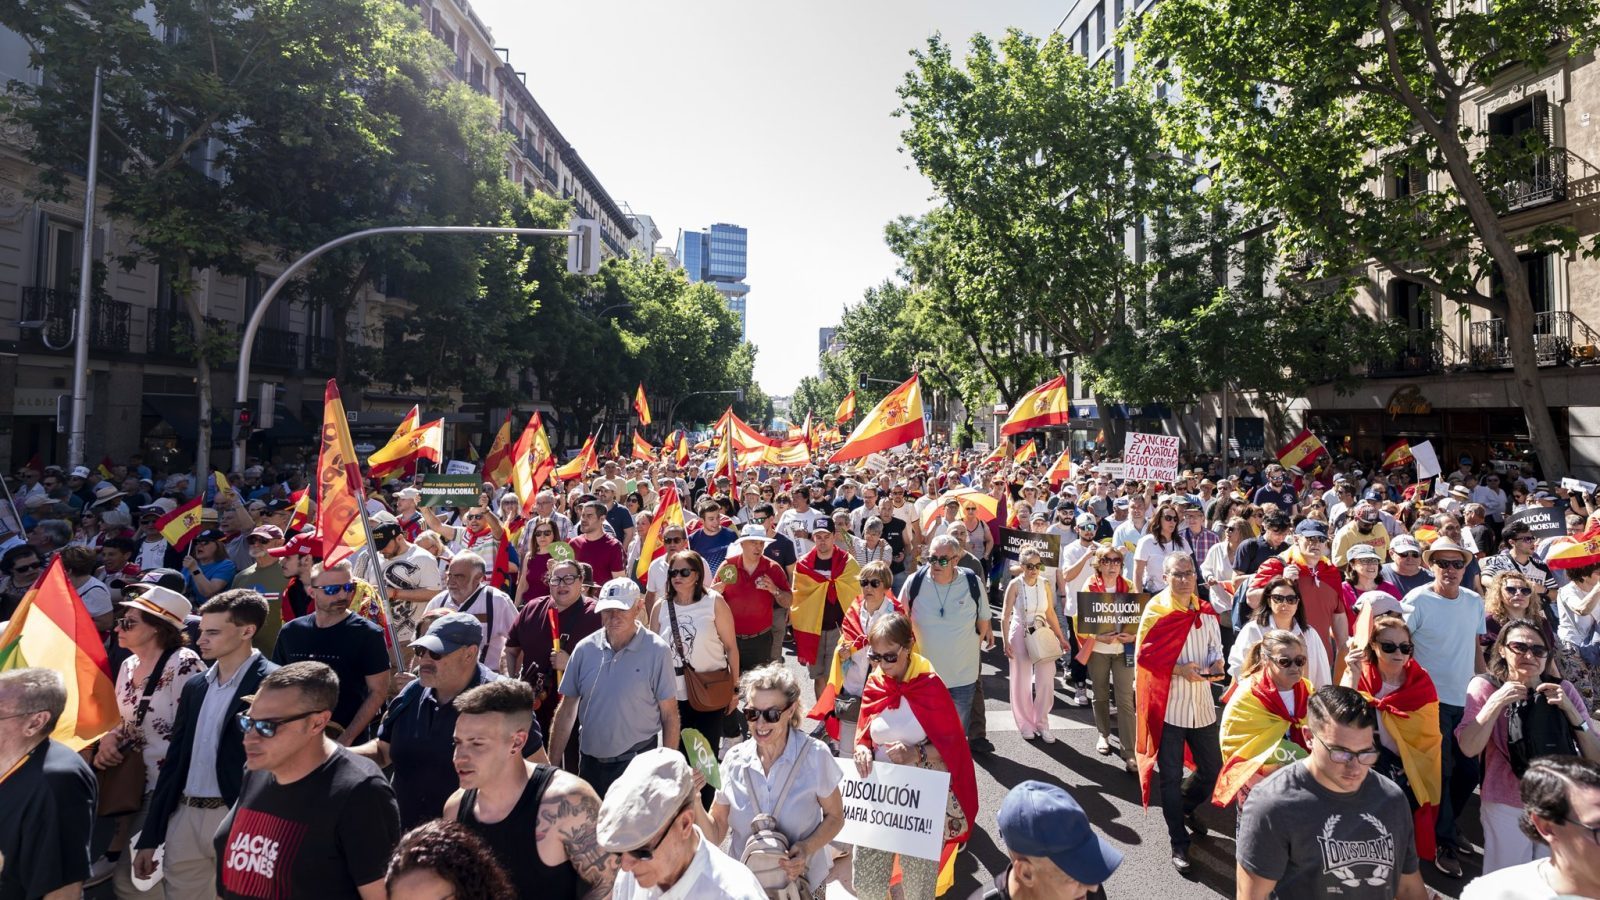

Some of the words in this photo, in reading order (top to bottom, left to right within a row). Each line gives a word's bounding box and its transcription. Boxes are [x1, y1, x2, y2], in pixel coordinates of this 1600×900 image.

[1129, 444, 1141, 455] EL
[1143, 445, 1178, 458] AYATOLA
[1136, 467, 1148, 479] LA
[447, 487, 475, 495] NACIONAL
[1515, 511, 1551, 525] OLUCIÓN
[1529, 522, 1560, 531] ANCHISTA!!
[1092, 601, 1140, 613] ¡DISOLUCIÓN
[1097, 615, 1117, 624] MAFIA
[693, 737, 714, 775] VOX
[1273, 747, 1297, 761] OX
[841, 779, 921, 809] ¡DISOLUCIÓN
[869, 809, 933, 835] SOCIALISTA!!
[1316, 832, 1395, 875] LONSDALE
[226, 850, 274, 878] JONES
